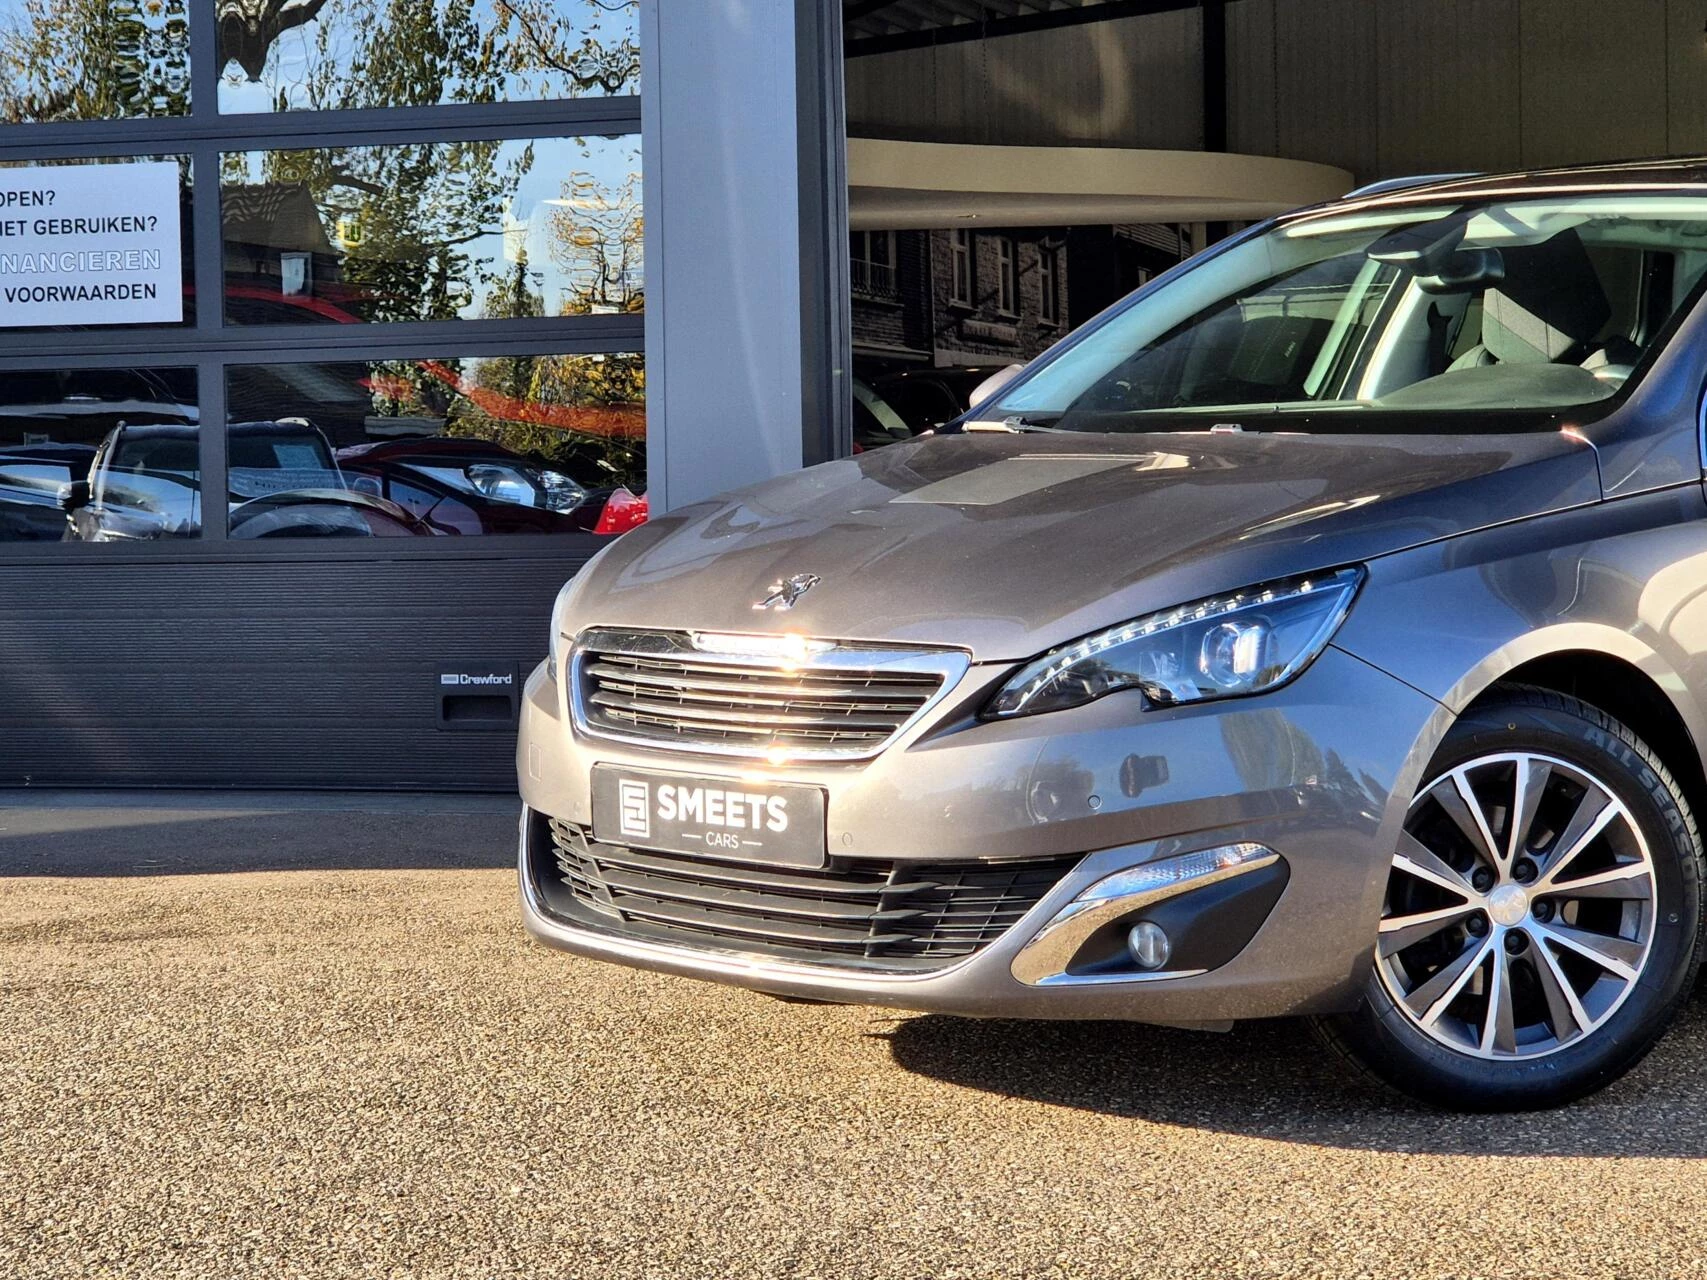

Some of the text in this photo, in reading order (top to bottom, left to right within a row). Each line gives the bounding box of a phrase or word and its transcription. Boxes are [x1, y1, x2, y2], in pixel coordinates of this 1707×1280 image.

[33, 216, 157, 236] GEBRUIKEN?
[1, 250, 160, 274] NANCIEREN
[5, 283, 156, 303] VOORWAARDEN
[460, 673, 512, 684] Crawford
[1584, 727, 1632, 767] ALL
[657, 785, 788, 832] SMEETS
[706, 832, 739, 849] CARS
